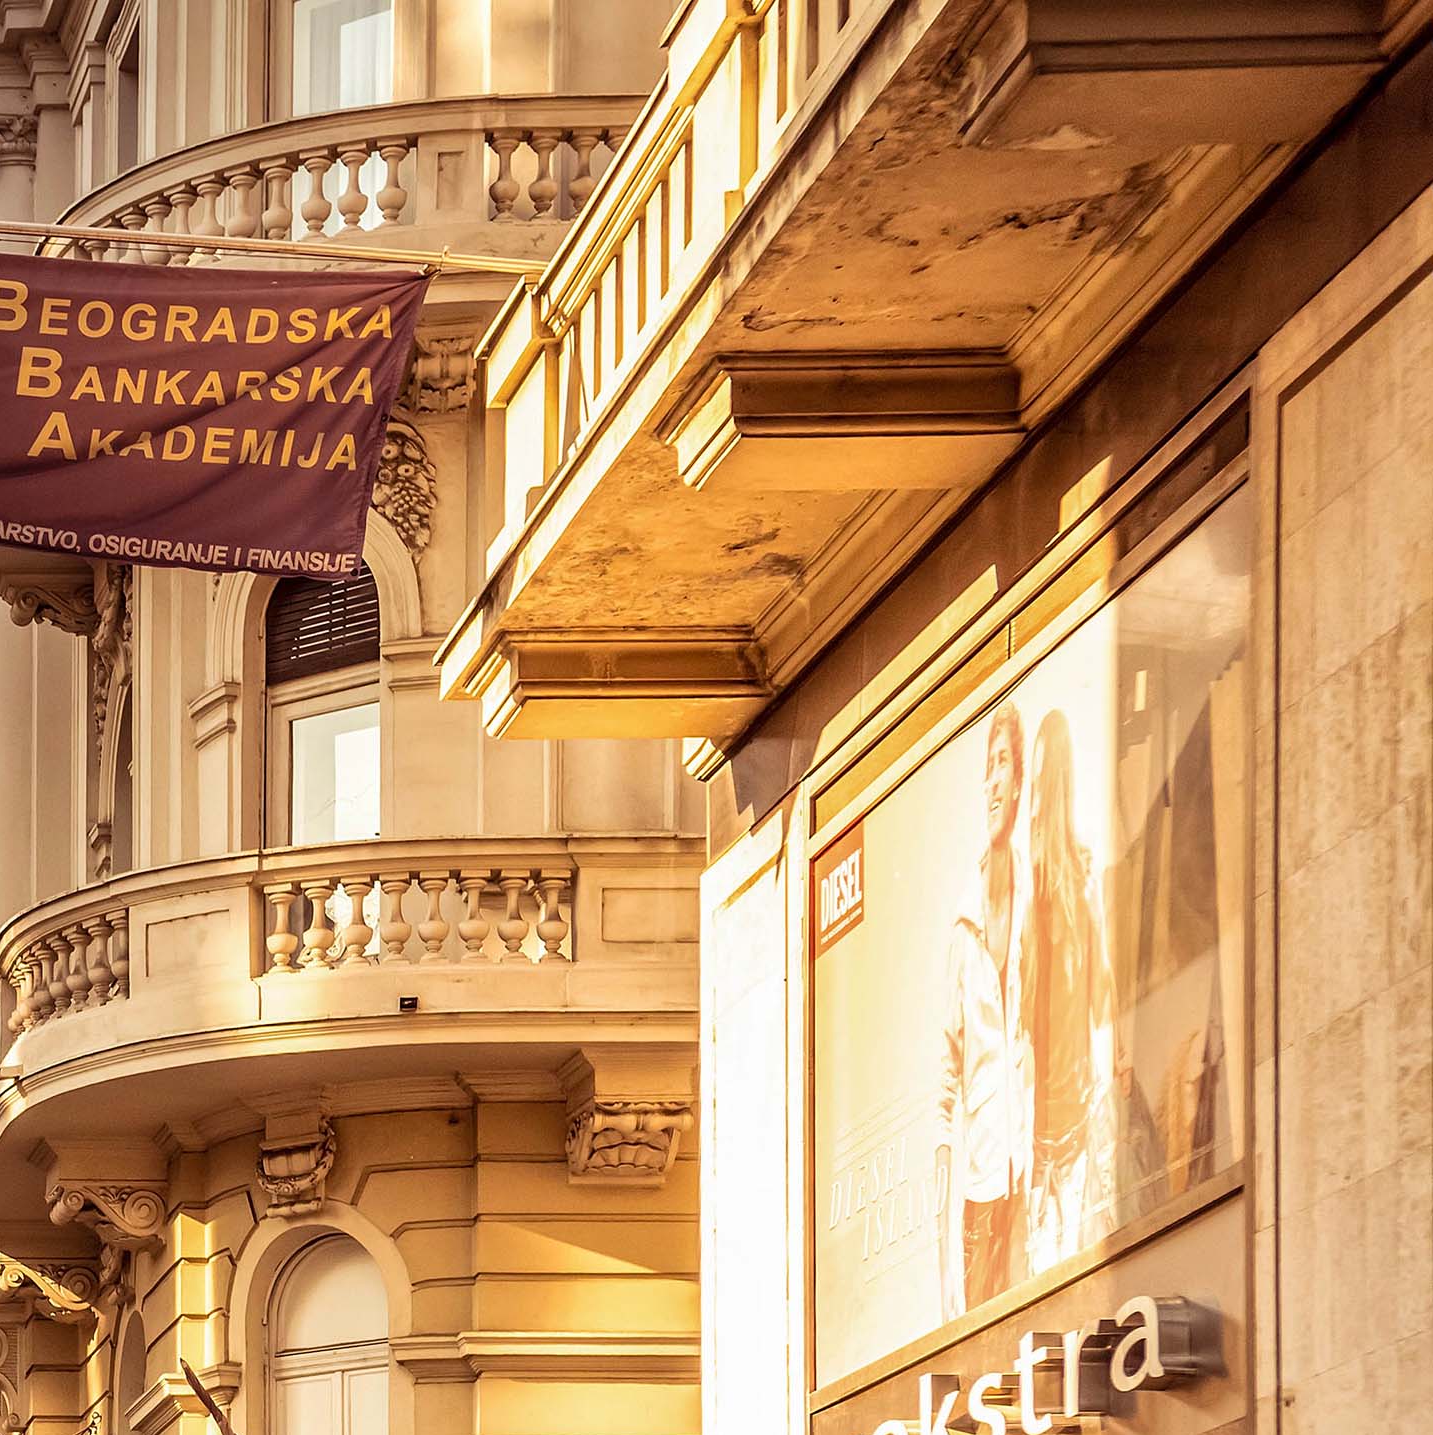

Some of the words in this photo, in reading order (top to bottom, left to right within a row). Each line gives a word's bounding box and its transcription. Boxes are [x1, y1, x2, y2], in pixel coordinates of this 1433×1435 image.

[16, 346, 374, 406] BANKARSKA
[28, 411, 357, 471] AKADEMIJA
[88, 533, 229, 565] OSIGURANJE
[234, 547, 242, 567] I
[246, 548, 356, 573] FINANSIJE
[820, 847, 863, 933] DIESEL
